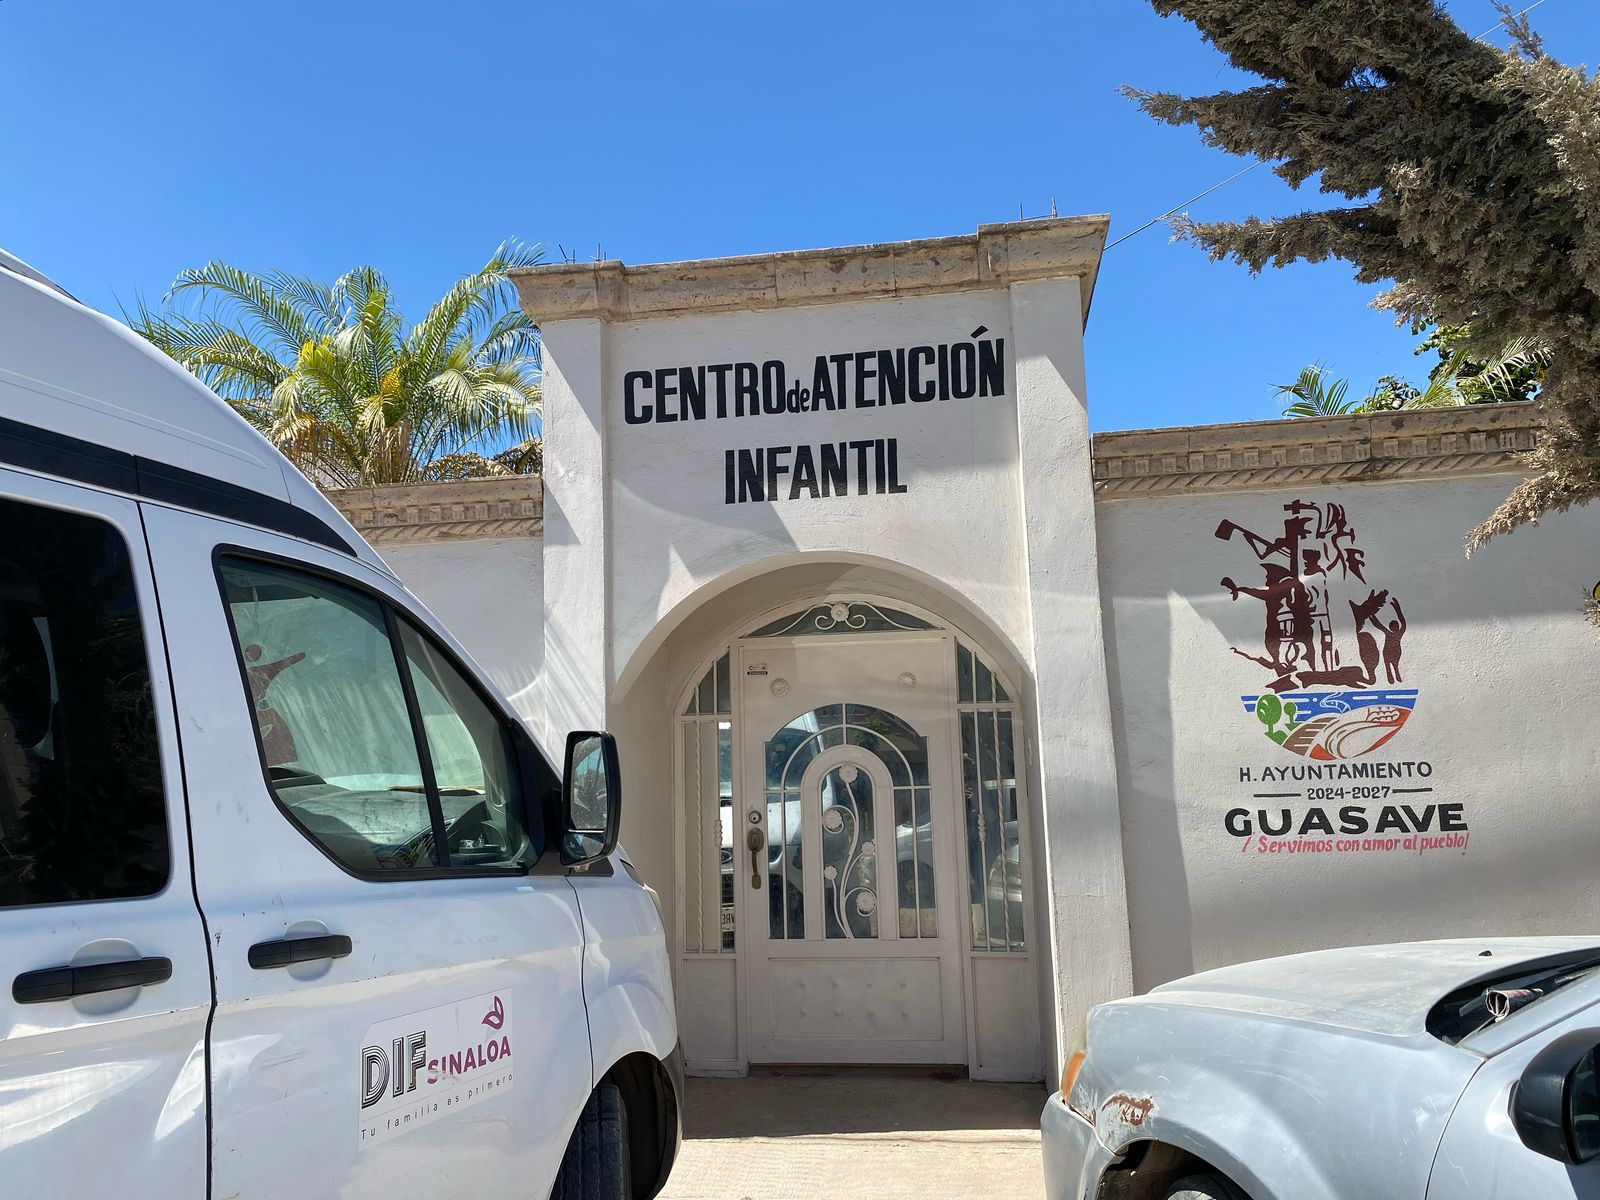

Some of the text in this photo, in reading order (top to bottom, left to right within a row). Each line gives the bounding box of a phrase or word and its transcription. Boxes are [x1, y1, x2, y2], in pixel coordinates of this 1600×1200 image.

[624, 325, 1005, 425] CENTRO de ATENCIÓN
[724, 438, 908, 505] INFANTIL
[1239, 761, 1433, 782] H. AYUNTAMIENTO
[1307, 786, 1391, 800] 2024-2027
[1224, 803, 1468, 837] GUASAVE
[1402, 834, 1418, 851] al
[361, 1030, 512, 1110] DIF SINALOA
[361, 1073, 513, 1140] Tu familia es primero
